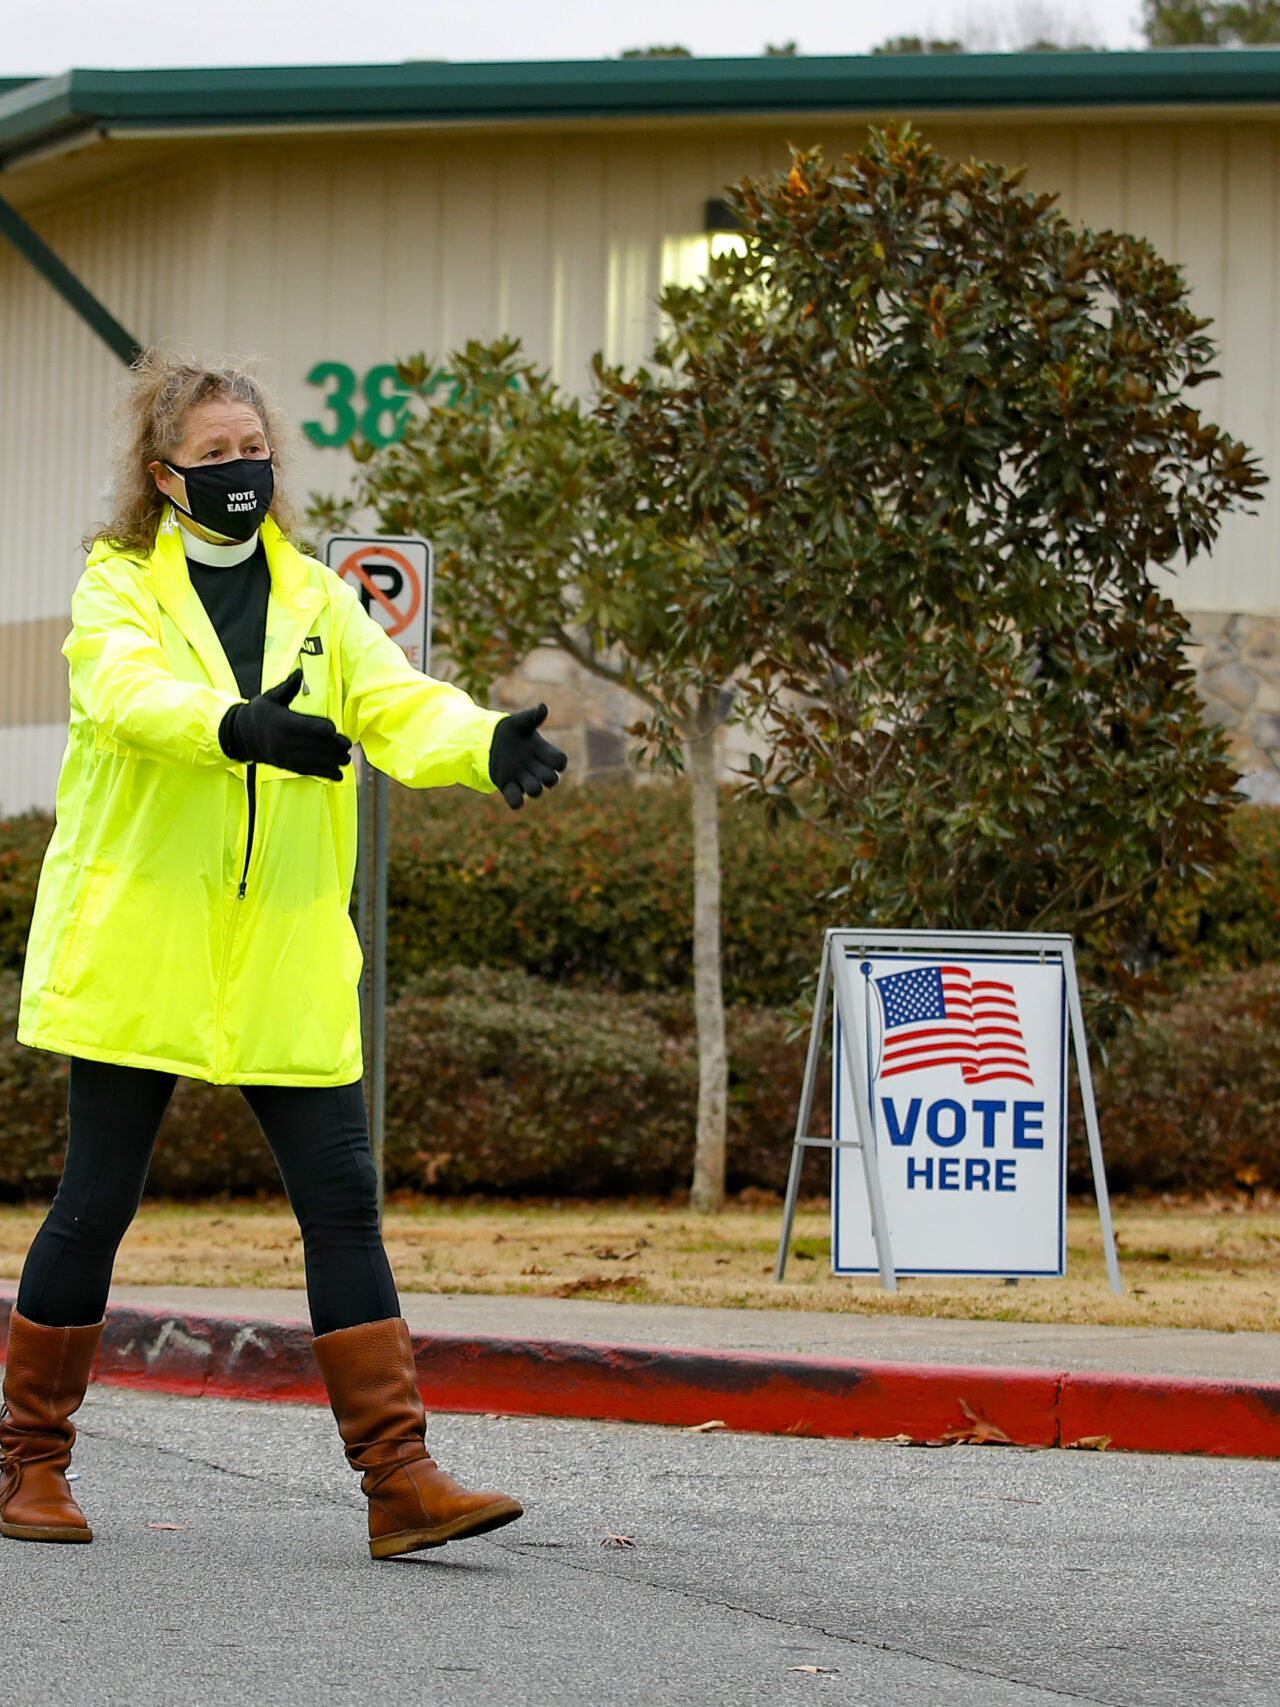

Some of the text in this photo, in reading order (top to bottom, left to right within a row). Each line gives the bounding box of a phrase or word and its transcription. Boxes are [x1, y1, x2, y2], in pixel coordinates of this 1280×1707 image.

[303, 361, 521, 449] 38
[227, 490, 256, 502] VOTE
[227, 500, 257, 512] EARLY
[881, 1096, 1045, 1150] VOTE
[906, 1157, 1017, 1192] HERE
